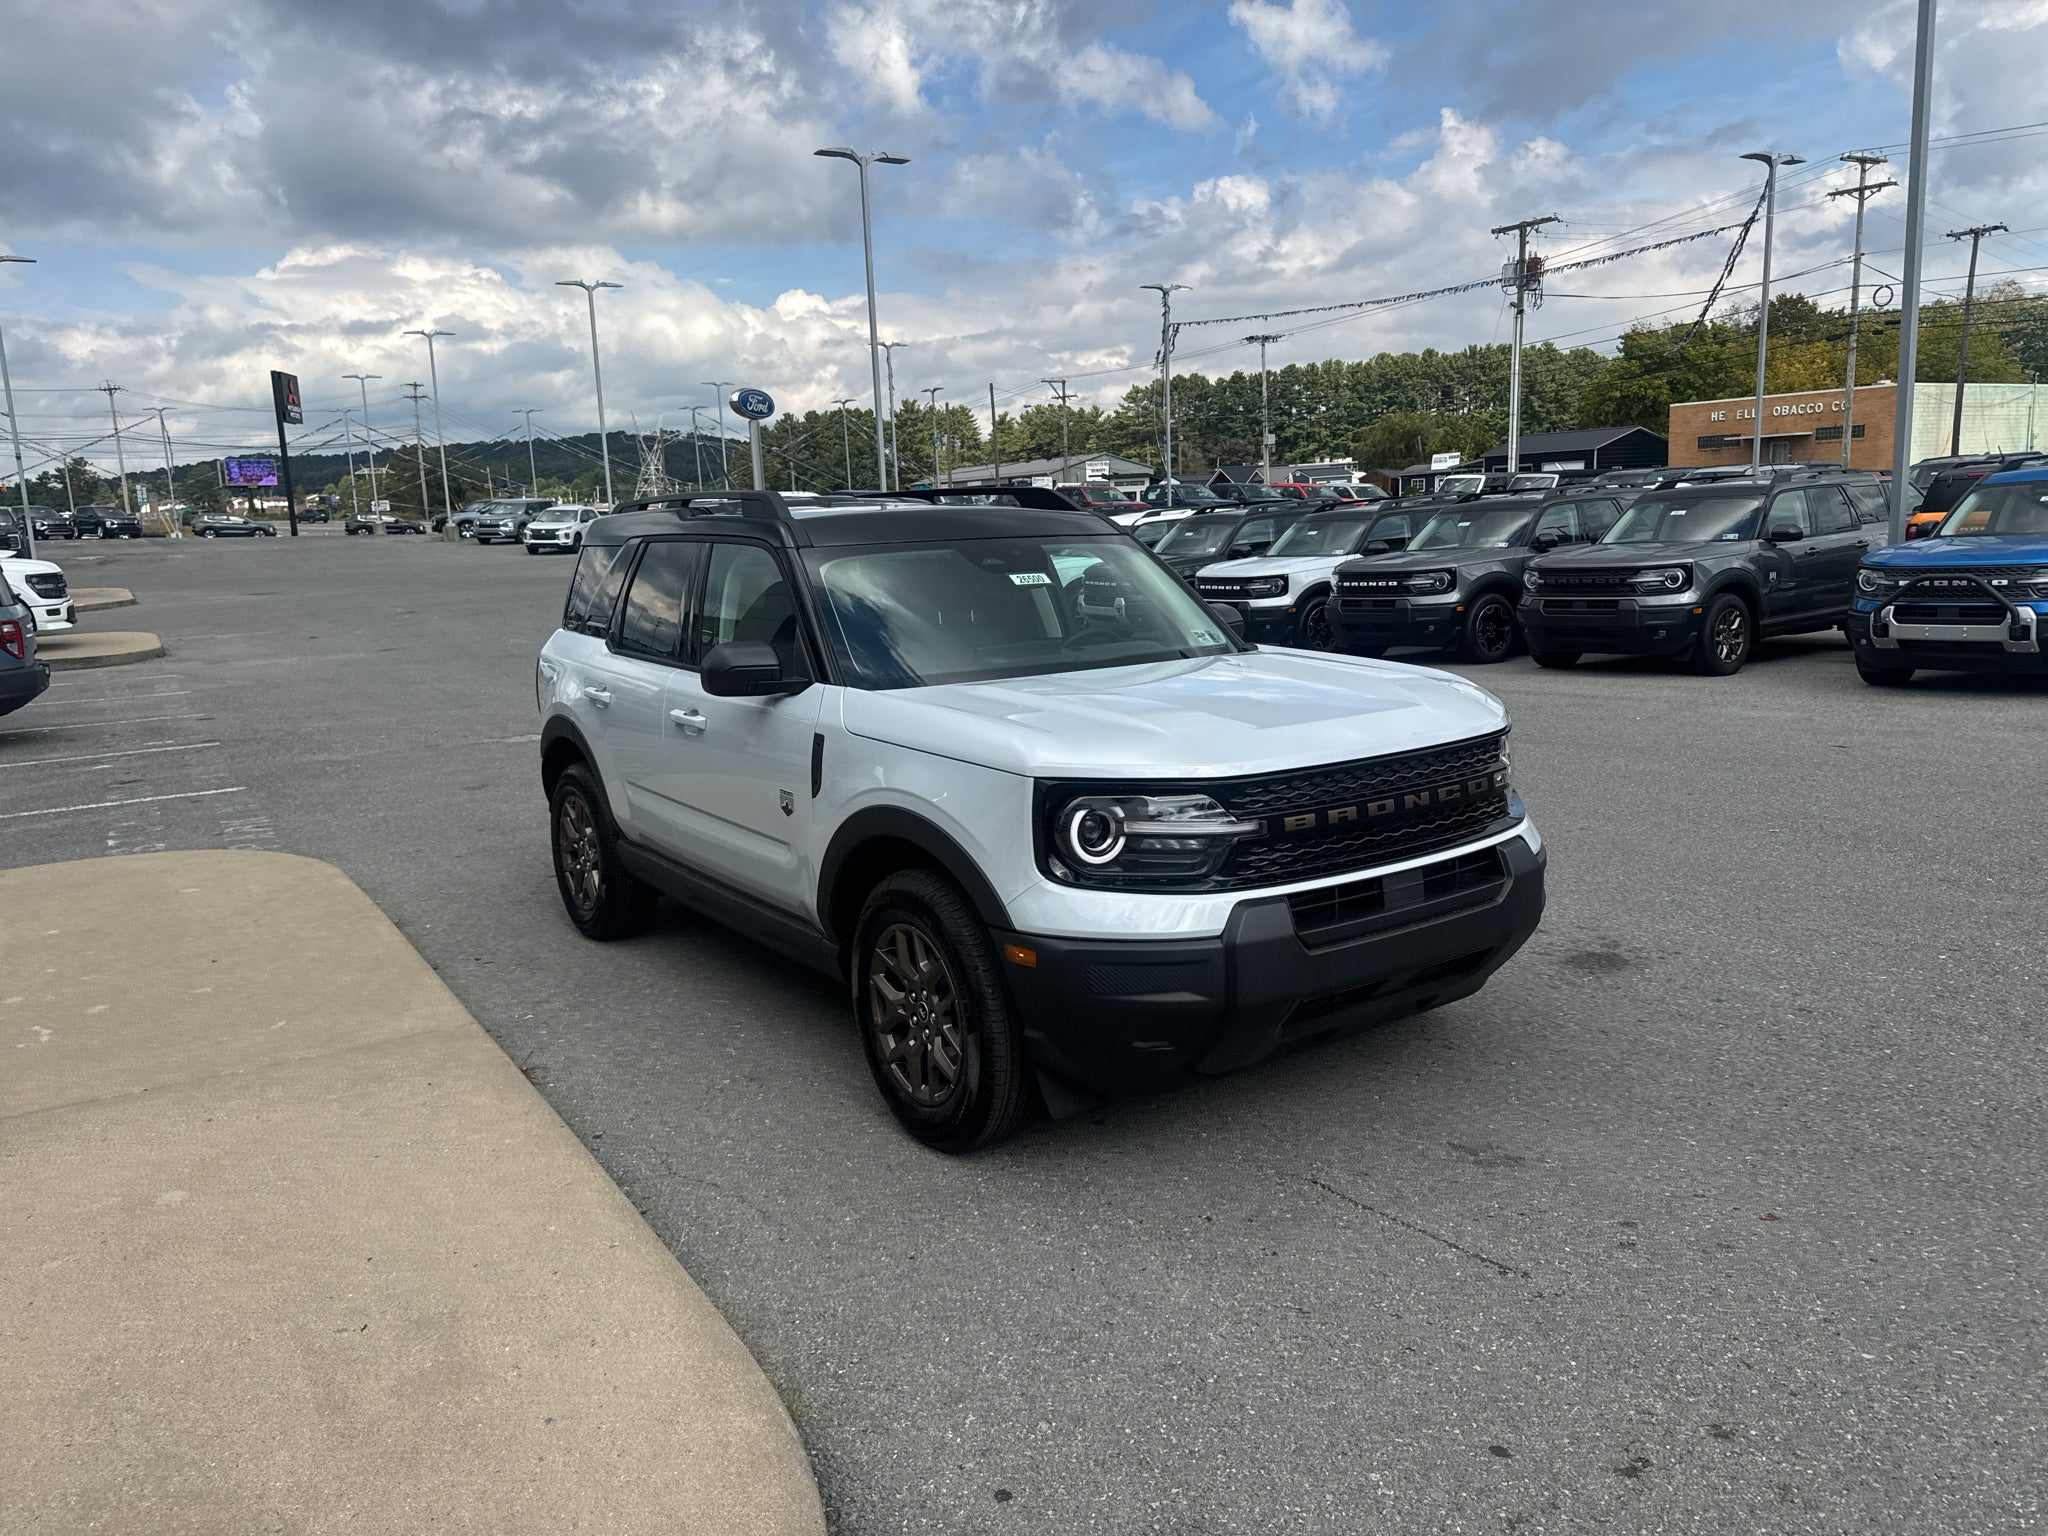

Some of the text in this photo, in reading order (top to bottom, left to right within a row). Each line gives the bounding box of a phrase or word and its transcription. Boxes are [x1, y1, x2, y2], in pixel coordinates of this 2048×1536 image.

[747, 394, 769, 413] Ford
[1016, 574, 1046, 584] 26500
[1283, 777, 1489, 832] BRONCO
